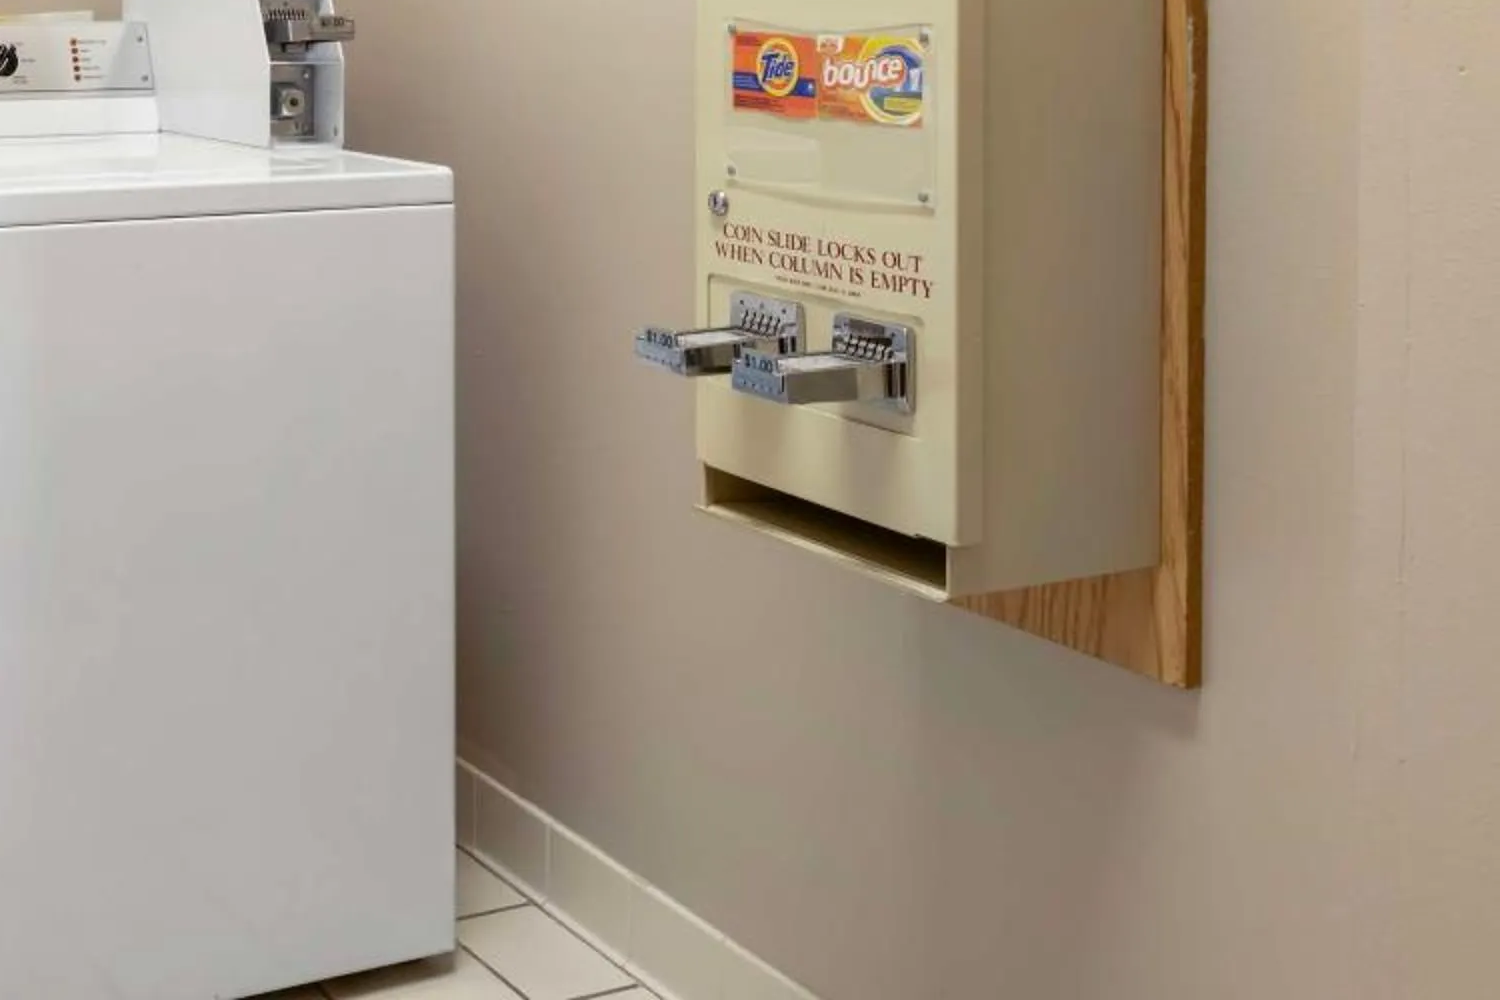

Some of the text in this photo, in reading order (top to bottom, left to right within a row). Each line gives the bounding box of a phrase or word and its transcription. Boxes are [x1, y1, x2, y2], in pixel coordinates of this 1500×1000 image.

[761, 52, 795, 82] Tide
[823, 55, 902, 88] bounce
[723, 222, 923, 273] COIN SLIDE LOCKS OUT
[715, 240, 763, 265] WHEN
[769, 252, 843, 280] COLUMN
[850, 266, 864, 286] IS
[871, 271, 934, 298] EMPTY
